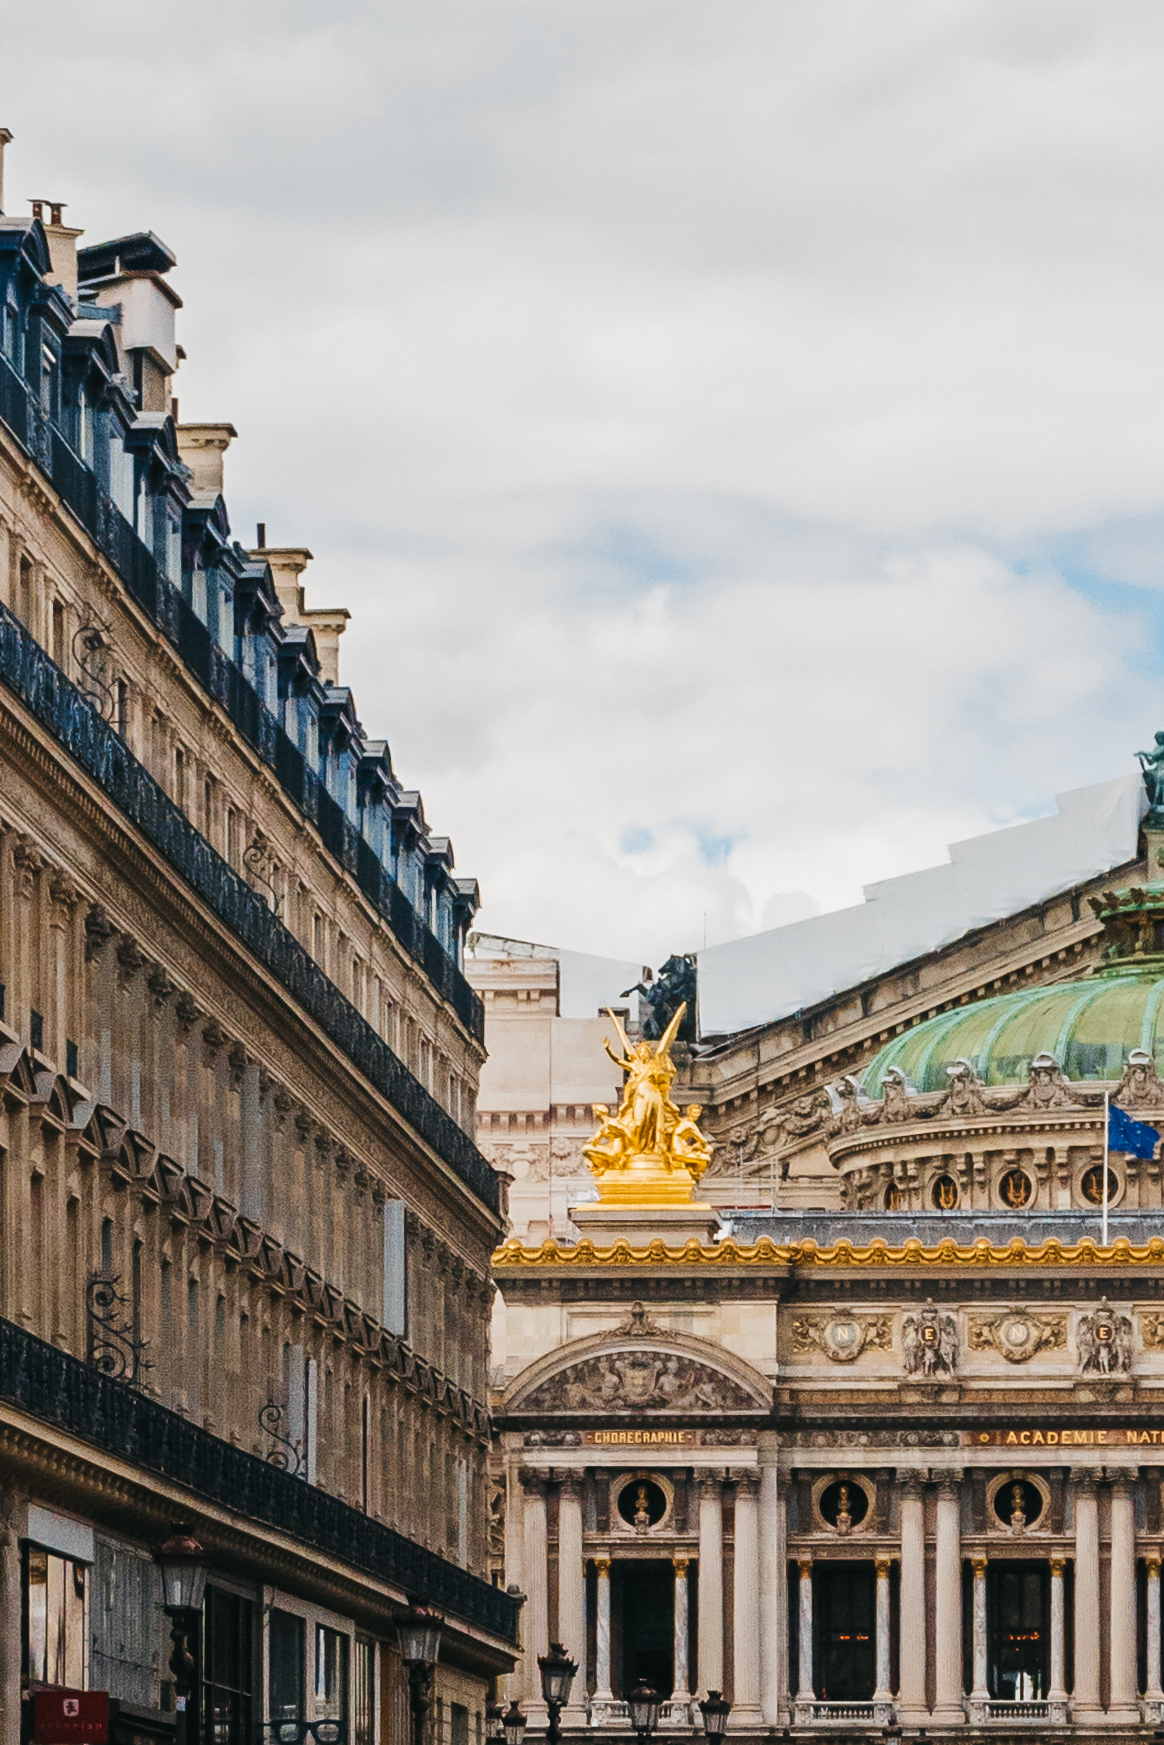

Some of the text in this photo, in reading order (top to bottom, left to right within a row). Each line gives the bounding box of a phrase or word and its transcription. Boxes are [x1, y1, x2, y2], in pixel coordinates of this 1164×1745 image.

[836, 1328, 849, 1340] N
[924, 1327, 934, 1339] E
[1010, 1327, 1023, 1339] N
[1099, 1327, 1109, 1339] E
[1006, 1430, 1108, 1444] ACADEMIE
